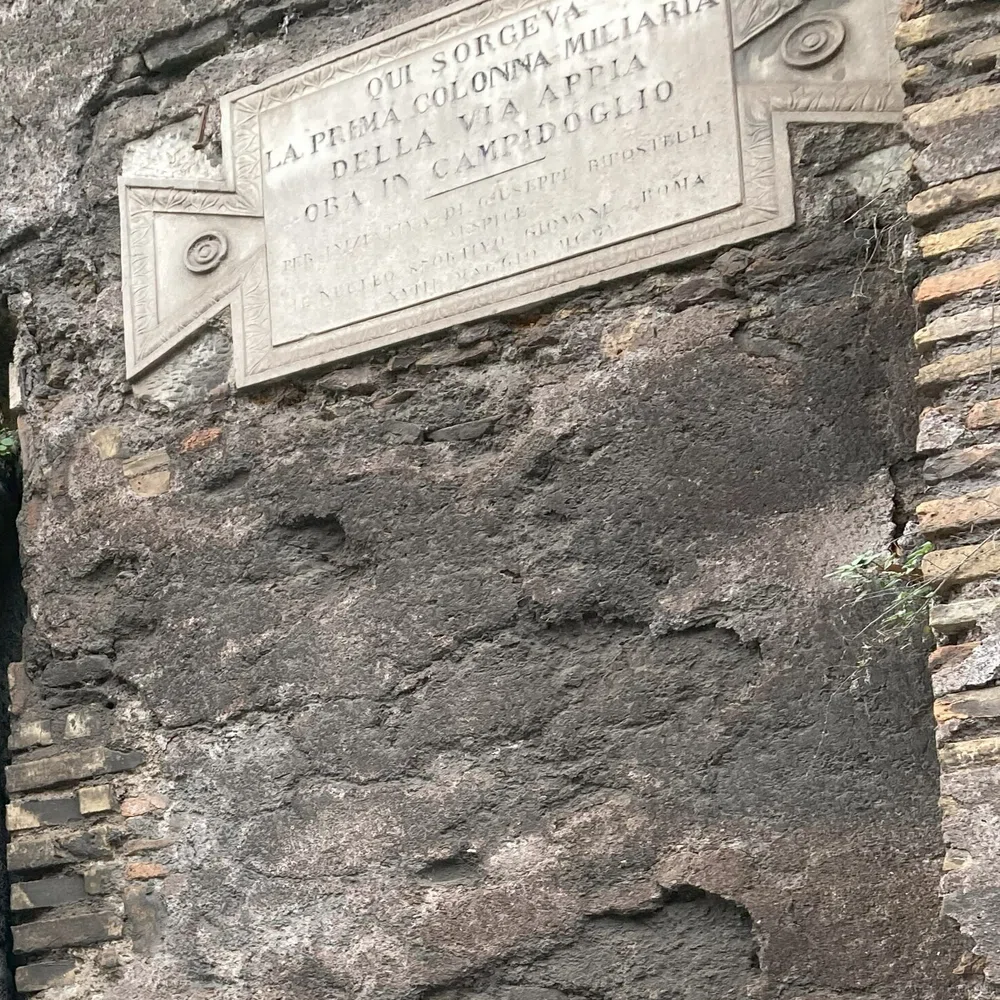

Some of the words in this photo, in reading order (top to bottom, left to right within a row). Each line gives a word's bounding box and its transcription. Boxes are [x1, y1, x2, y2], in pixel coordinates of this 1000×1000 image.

[266, 143, 303, 173] LA
[310, 107, 402, 154] PRIMA
[412, 50, 553, 114] COLONNA
[564, 0, 721, 60] MILIARIA
[331, 128, 436, 181] DELLA
[457, 98, 520, 133] VIA
[537, 54, 648, 108] APPIA
[367, 64, 413, 100] QUI
[431, 1, 587, 75] SORGEVA
[304, 190, 363, 223] ORA
[432, 80, 674, 179] CAMPIDOGLIO
